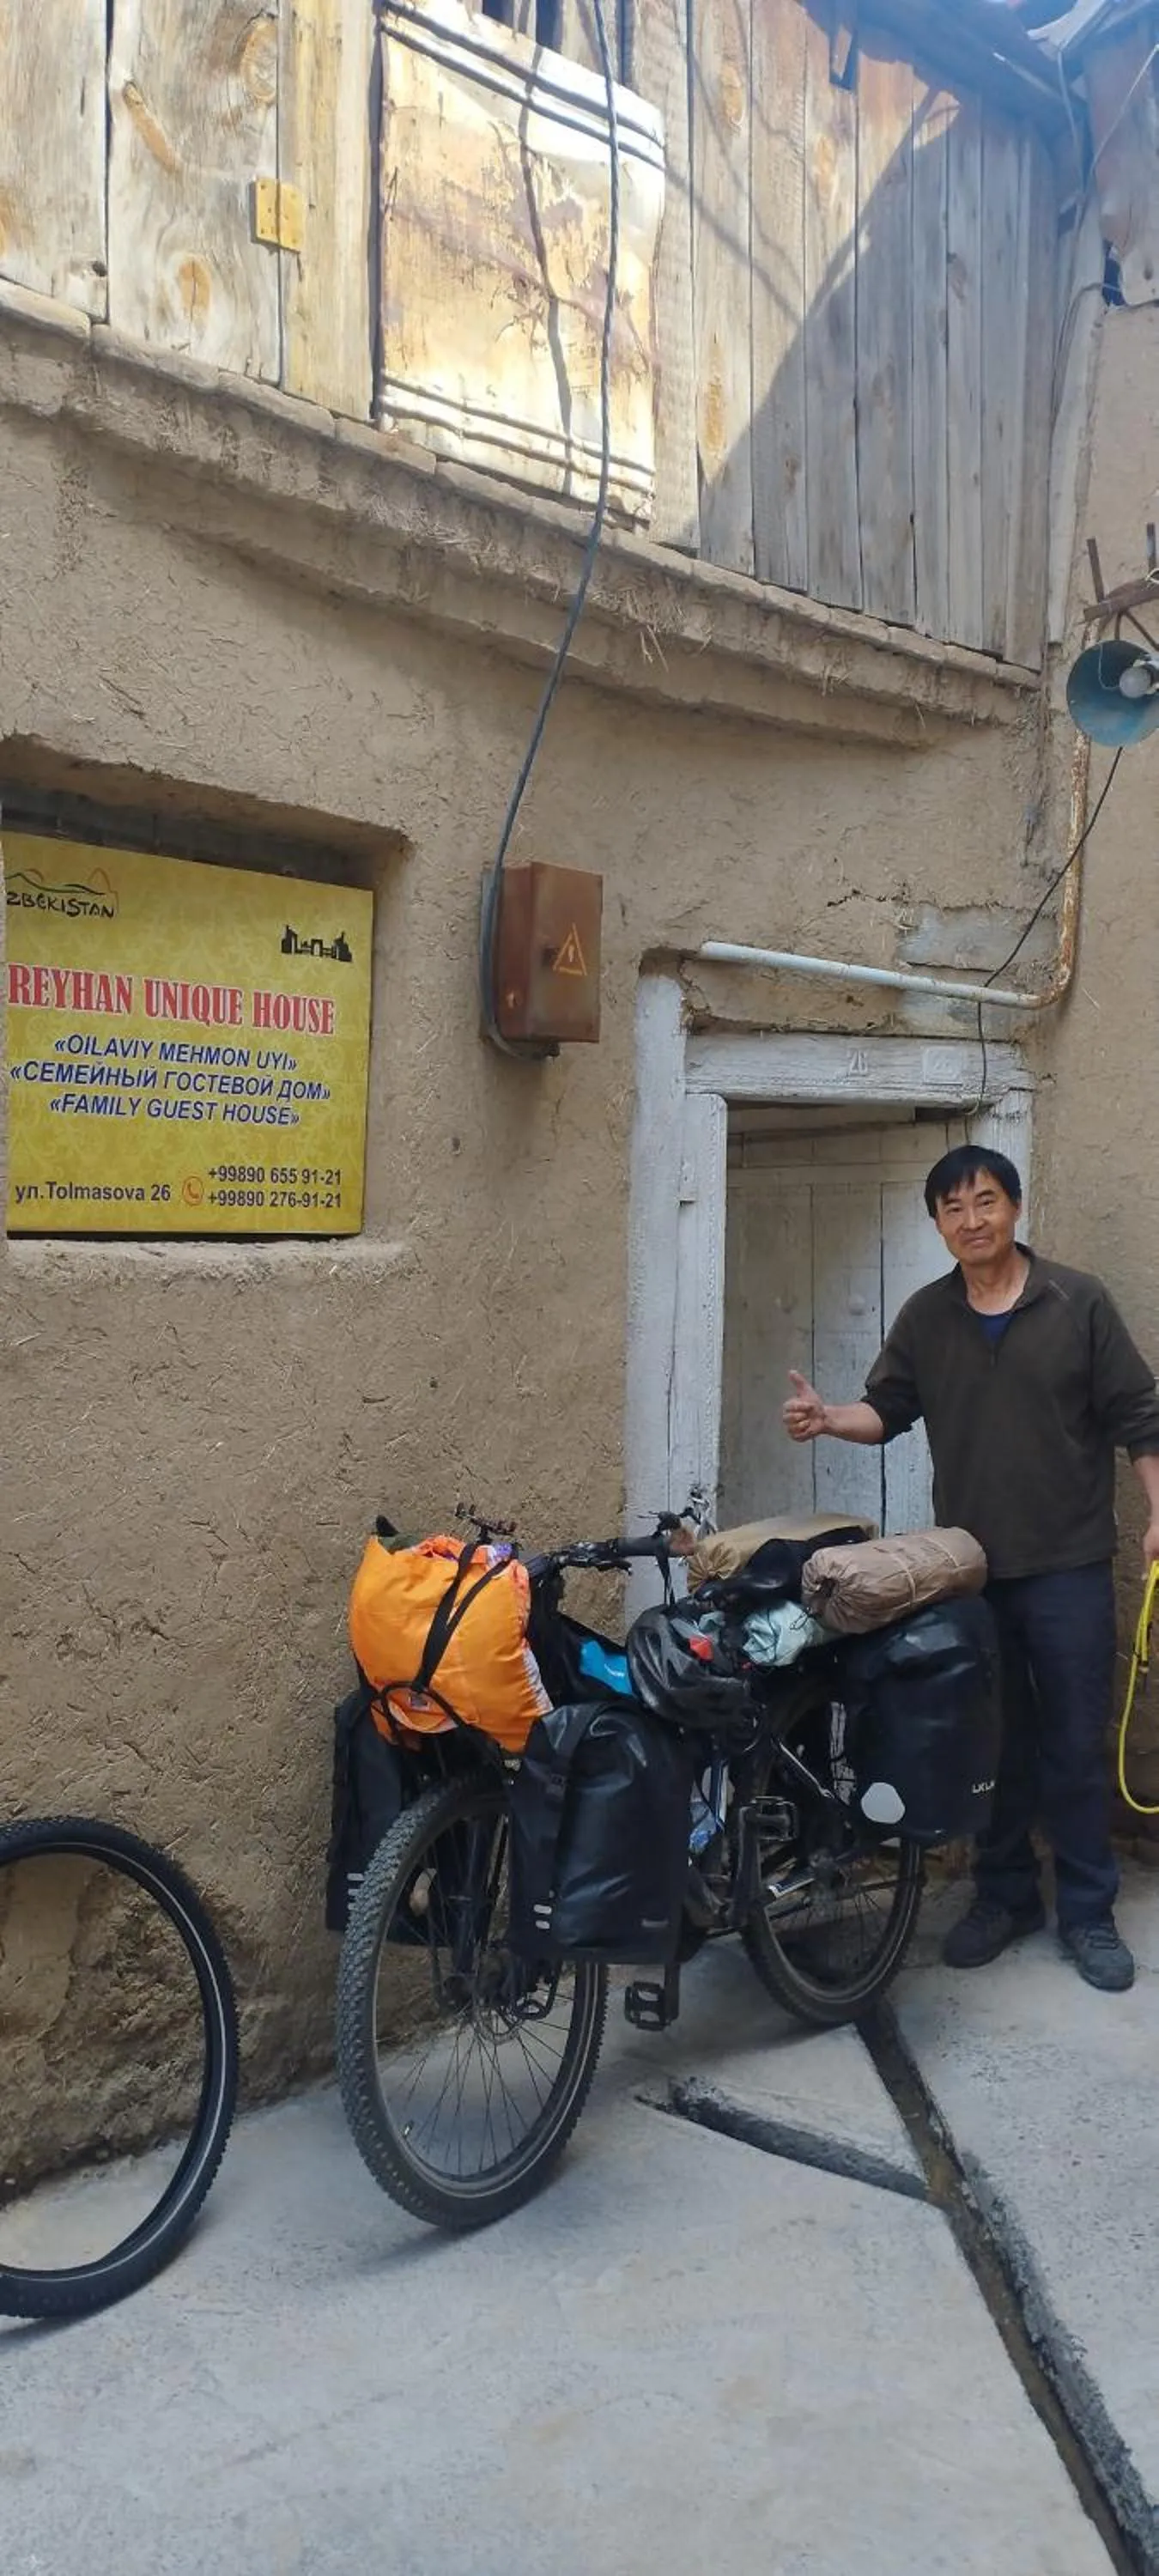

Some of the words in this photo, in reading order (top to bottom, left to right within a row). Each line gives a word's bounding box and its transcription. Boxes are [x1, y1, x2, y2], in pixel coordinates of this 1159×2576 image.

[6, 891, 115, 920] ZBEKISTAN
[8, 963, 133, 1013] REYHAN
[143, 978, 243, 1026] UNIQUE
[252, 991, 334, 1036] HOUSE
[54, 1034, 154, 1059] «OILAVIY
[159, 1042, 251, 1068] MEHMON
[257, 1050, 298, 1072] UYI»
[9, 1060, 158, 1089] «СЕМЕЙНЫЙ
[163, 1072, 275, 1097] ГОСТЕВОЙ
[276, 1079, 331, 1103] ДОМ»
[50, 1093, 143, 1117] «FAMILY
[147, 1098, 219, 1121] GUEST
[222, 1103, 300, 1126] HOUSE»
[208, 1164, 265, 1184] +99890
[270, 1167, 298, 1184] 655
[301, 1168, 343, 1186] 91-21
[150, 1184, 172, 1201] 26
[208, 1189, 265, 1207] +99890
[270, 1191, 343, 1208] 276-91-21
